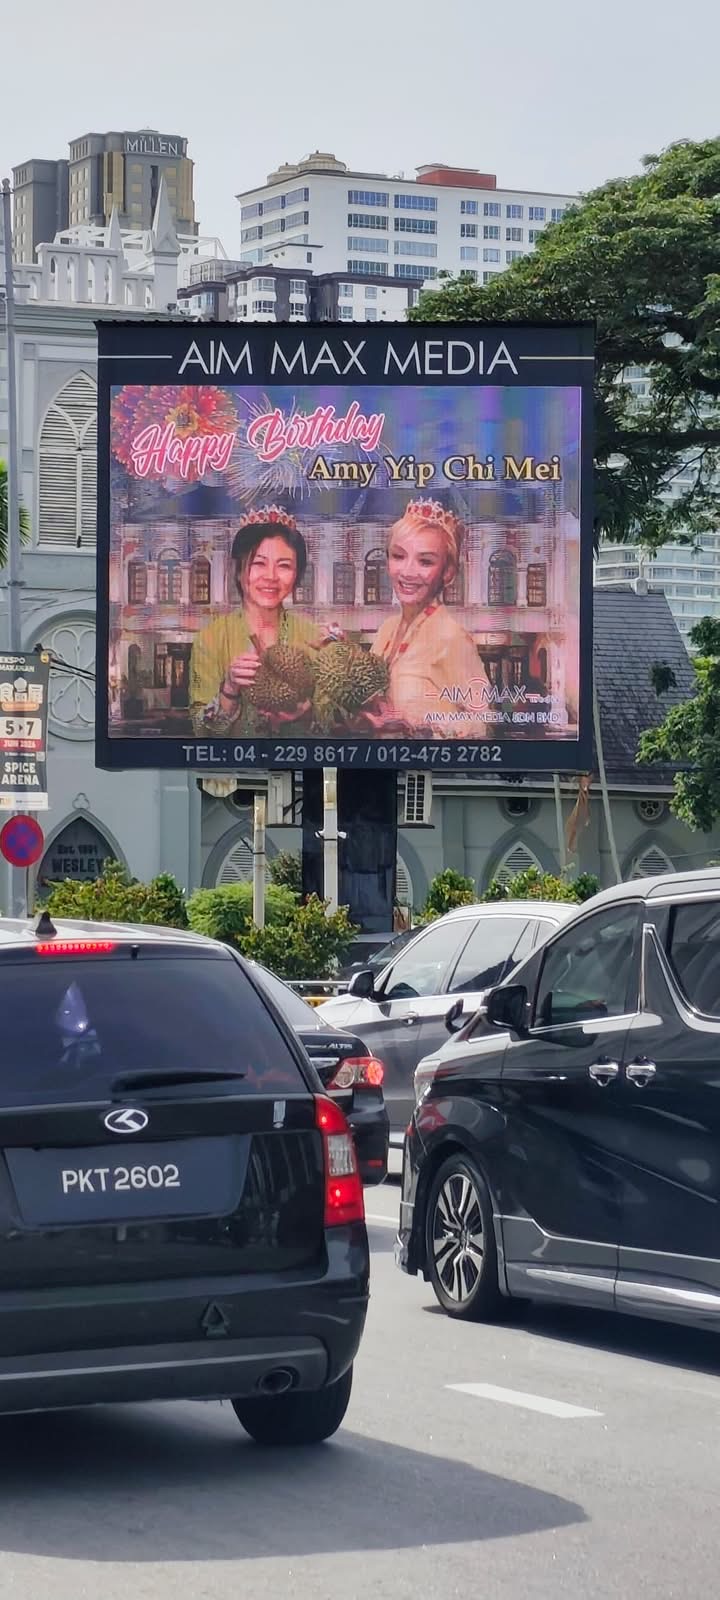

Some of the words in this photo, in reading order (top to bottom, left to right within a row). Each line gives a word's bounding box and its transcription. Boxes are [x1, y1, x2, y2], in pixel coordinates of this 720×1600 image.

[126, 139, 178, 155] MILLEN
[178, 340, 253, 375] AIM
[270, 340, 367, 375] MAX
[383, 340, 519, 375] MEDIA
[131, 420, 236, 478] Happy
[246, 401, 386, 462] Birthday
[307, 455, 377, 486] Amy
[384, 455, 435, 488] Yip
[442, 455, 496, 481] Chi
[504, 455, 562, 481] Mei
[439, 686, 473, 702] AIM
[481, 685, 527, 703] MAX
[425, 712, 446, 723] AIM
[448, 712, 472, 722] MAX
[475, 712, 511, 723] MEDIA
[6, 720, 14, 735] 5
[26, 721, 34, 736] 7
[182, 745, 227, 762] TEL:
[233, 745, 256, 762] 04
[274, 745, 307, 762] 229
[313, 745, 358, 762] 8617
[377, 745, 451, 762] 012-475
[457, 745, 502, 762] 2782
[4, 761, 36, 773] SPICE
[1, 773, 40, 785] ARENA
[52, 858, 104, 873] WESLEY
[61, 1168, 110, 1194] PKT
[113, 1163, 181, 1191] 2602
